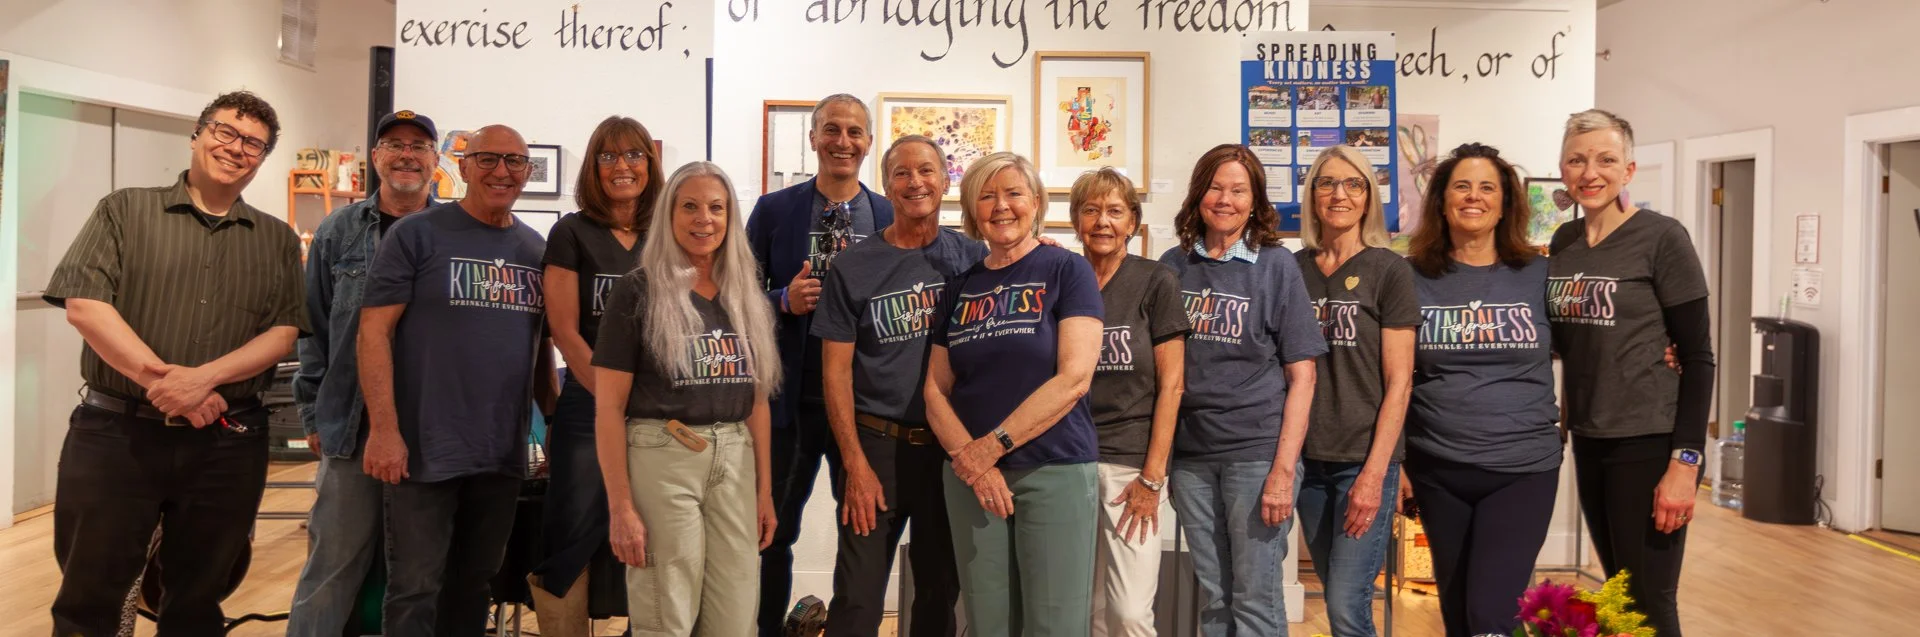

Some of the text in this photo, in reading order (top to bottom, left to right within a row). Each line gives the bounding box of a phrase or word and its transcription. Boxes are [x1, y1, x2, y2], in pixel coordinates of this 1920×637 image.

[400, 8, 533, 49] exercise
[1257, 43, 1376, 61] SPREADING
[1476, 52, 1513, 77] or
[1531, 31, 1566, 80] of
[1264, 60, 1371, 79] KINDNESS
[492, 279, 526, 294] free
[450, 299, 490, 308] SPRINKLE
[994, 327, 1036, 337] EVERYWHERE
[1419, 308, 1537, 343] KINDNESS
[1442, 321, 1506, 335] is free
[879, 334, 913, 344] SPRINKLE
[1194, 333, 1242, 345] EVERYWHERE
[1478, 342, 1540, 350] EVERYWHERE
